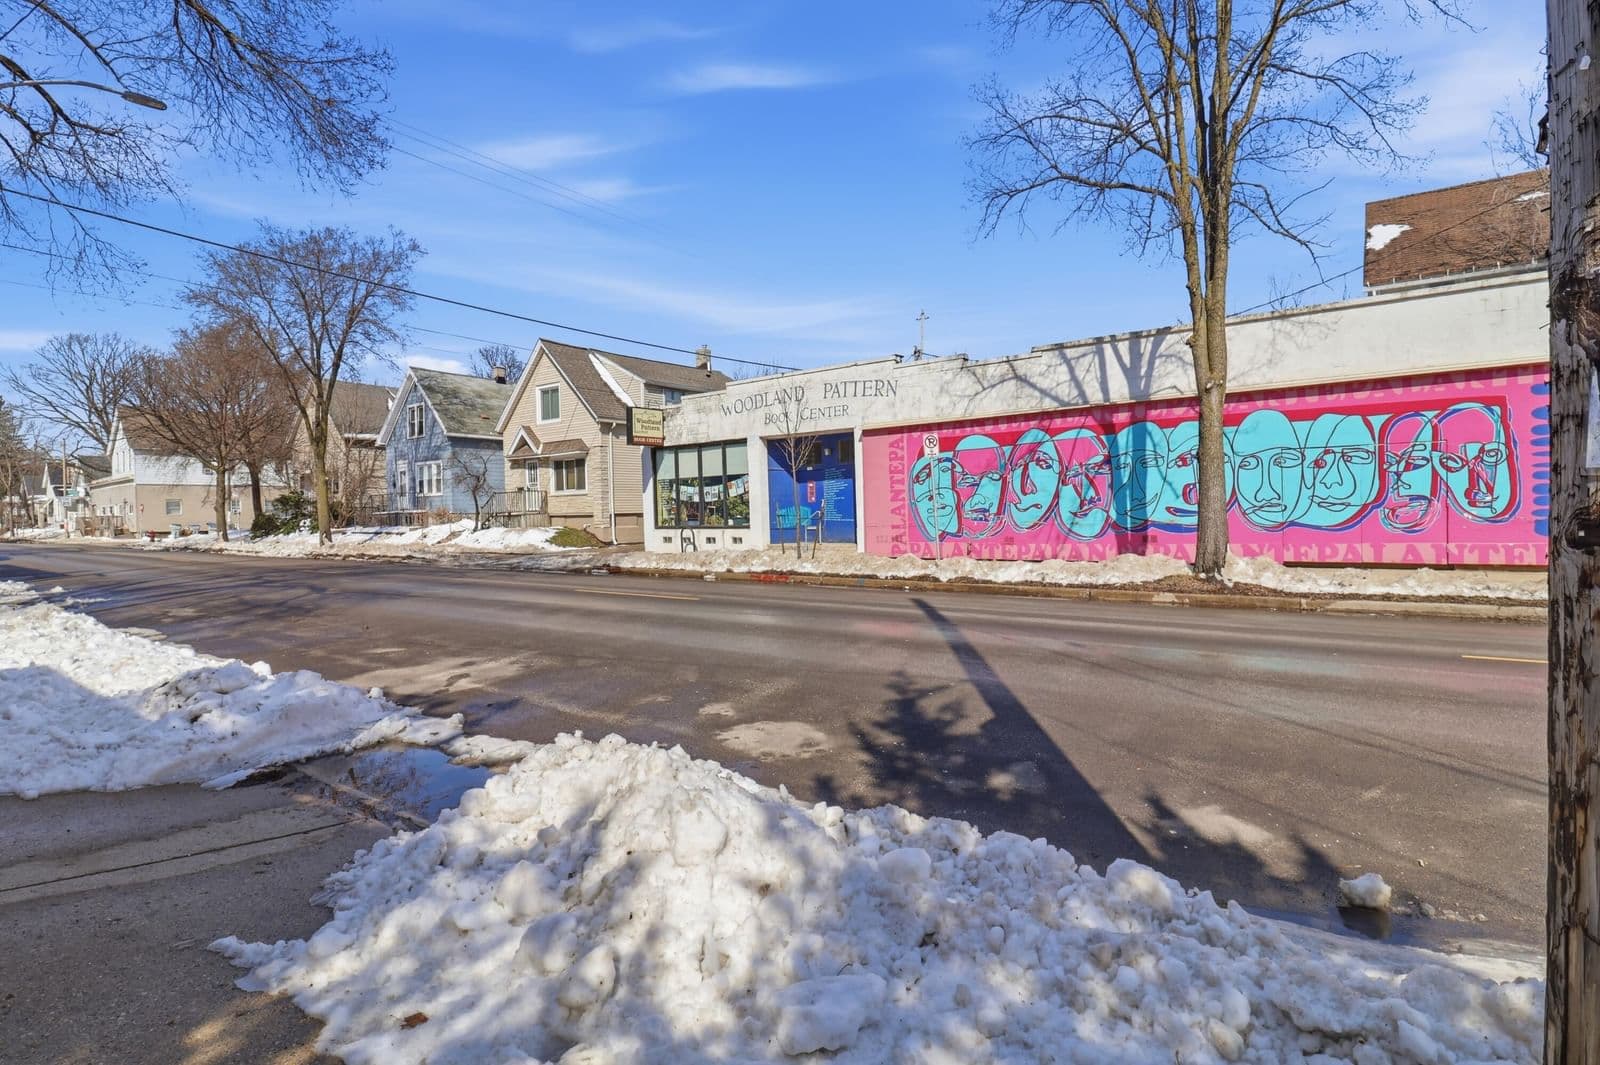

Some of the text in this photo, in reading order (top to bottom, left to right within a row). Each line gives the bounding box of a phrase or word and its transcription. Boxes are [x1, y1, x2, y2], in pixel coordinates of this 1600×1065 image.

[721, 379, 899, 417] WOODLAND PATTERN
[764, 404, 849, 425] BOOK CENTER
